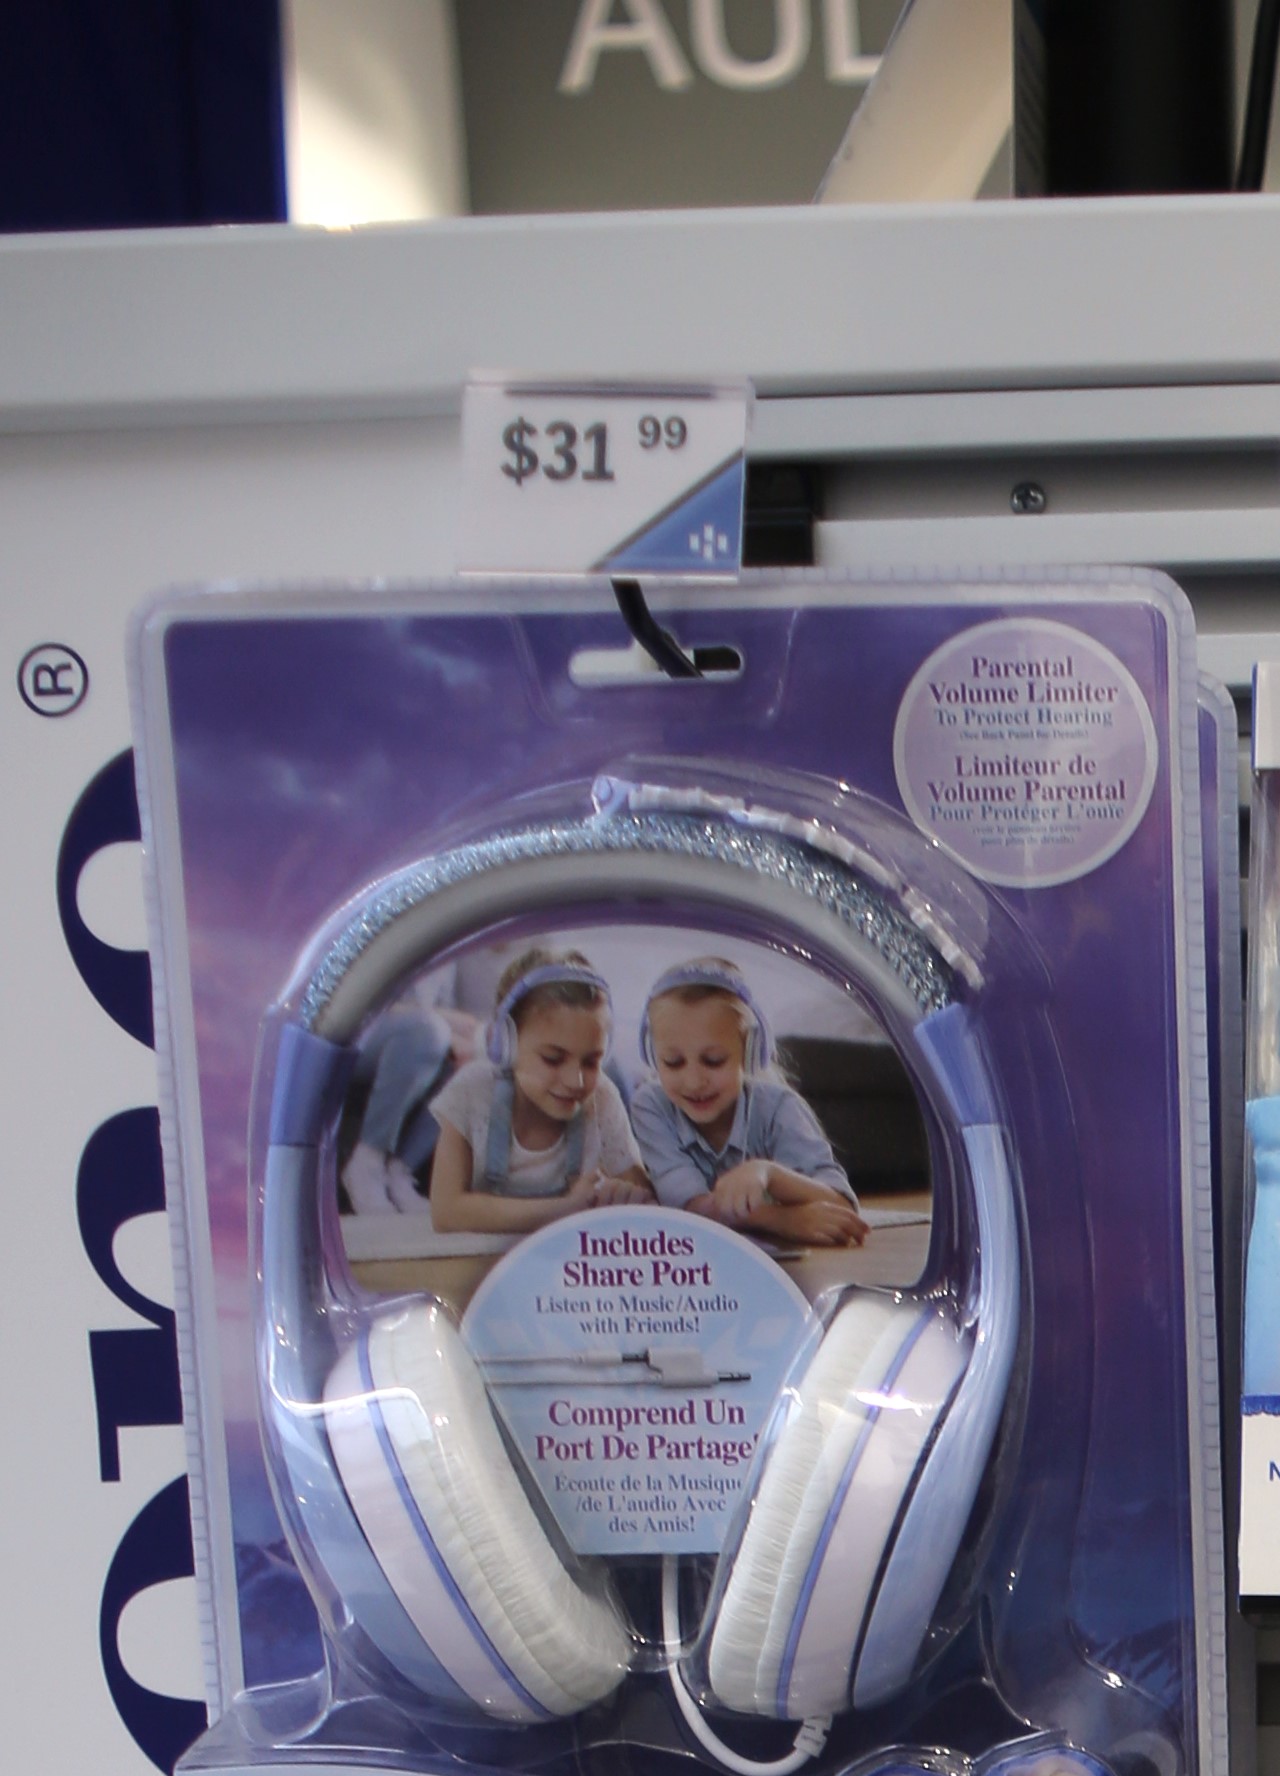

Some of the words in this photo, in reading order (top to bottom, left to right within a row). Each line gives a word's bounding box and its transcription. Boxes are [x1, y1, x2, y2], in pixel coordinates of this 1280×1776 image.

[501, 417, 615, 485] $31
[638, 416, 688, 450] 99
[971, 656, 1073, 678] Parental
[929, 683, 1018, 705] Volume
[1028, 682, 1118, 703] Limiter
[579, 1231, 694, 1257] Includes
[563, 1261, 644, 1288] Share
[652, 1261, 712, 1286] Port
[536, 1296, 591, 1314] Listen
[596, 1297, 614, 1313] to
[619, 1295, 738, 1313] Music/Audio
[580, 1318, 619, 1334] with
[625, 1318, 700, 1333] Friends!
[548, 1400, 696, 1432] Comprend
[705, 1400, 745, 1424] Un
